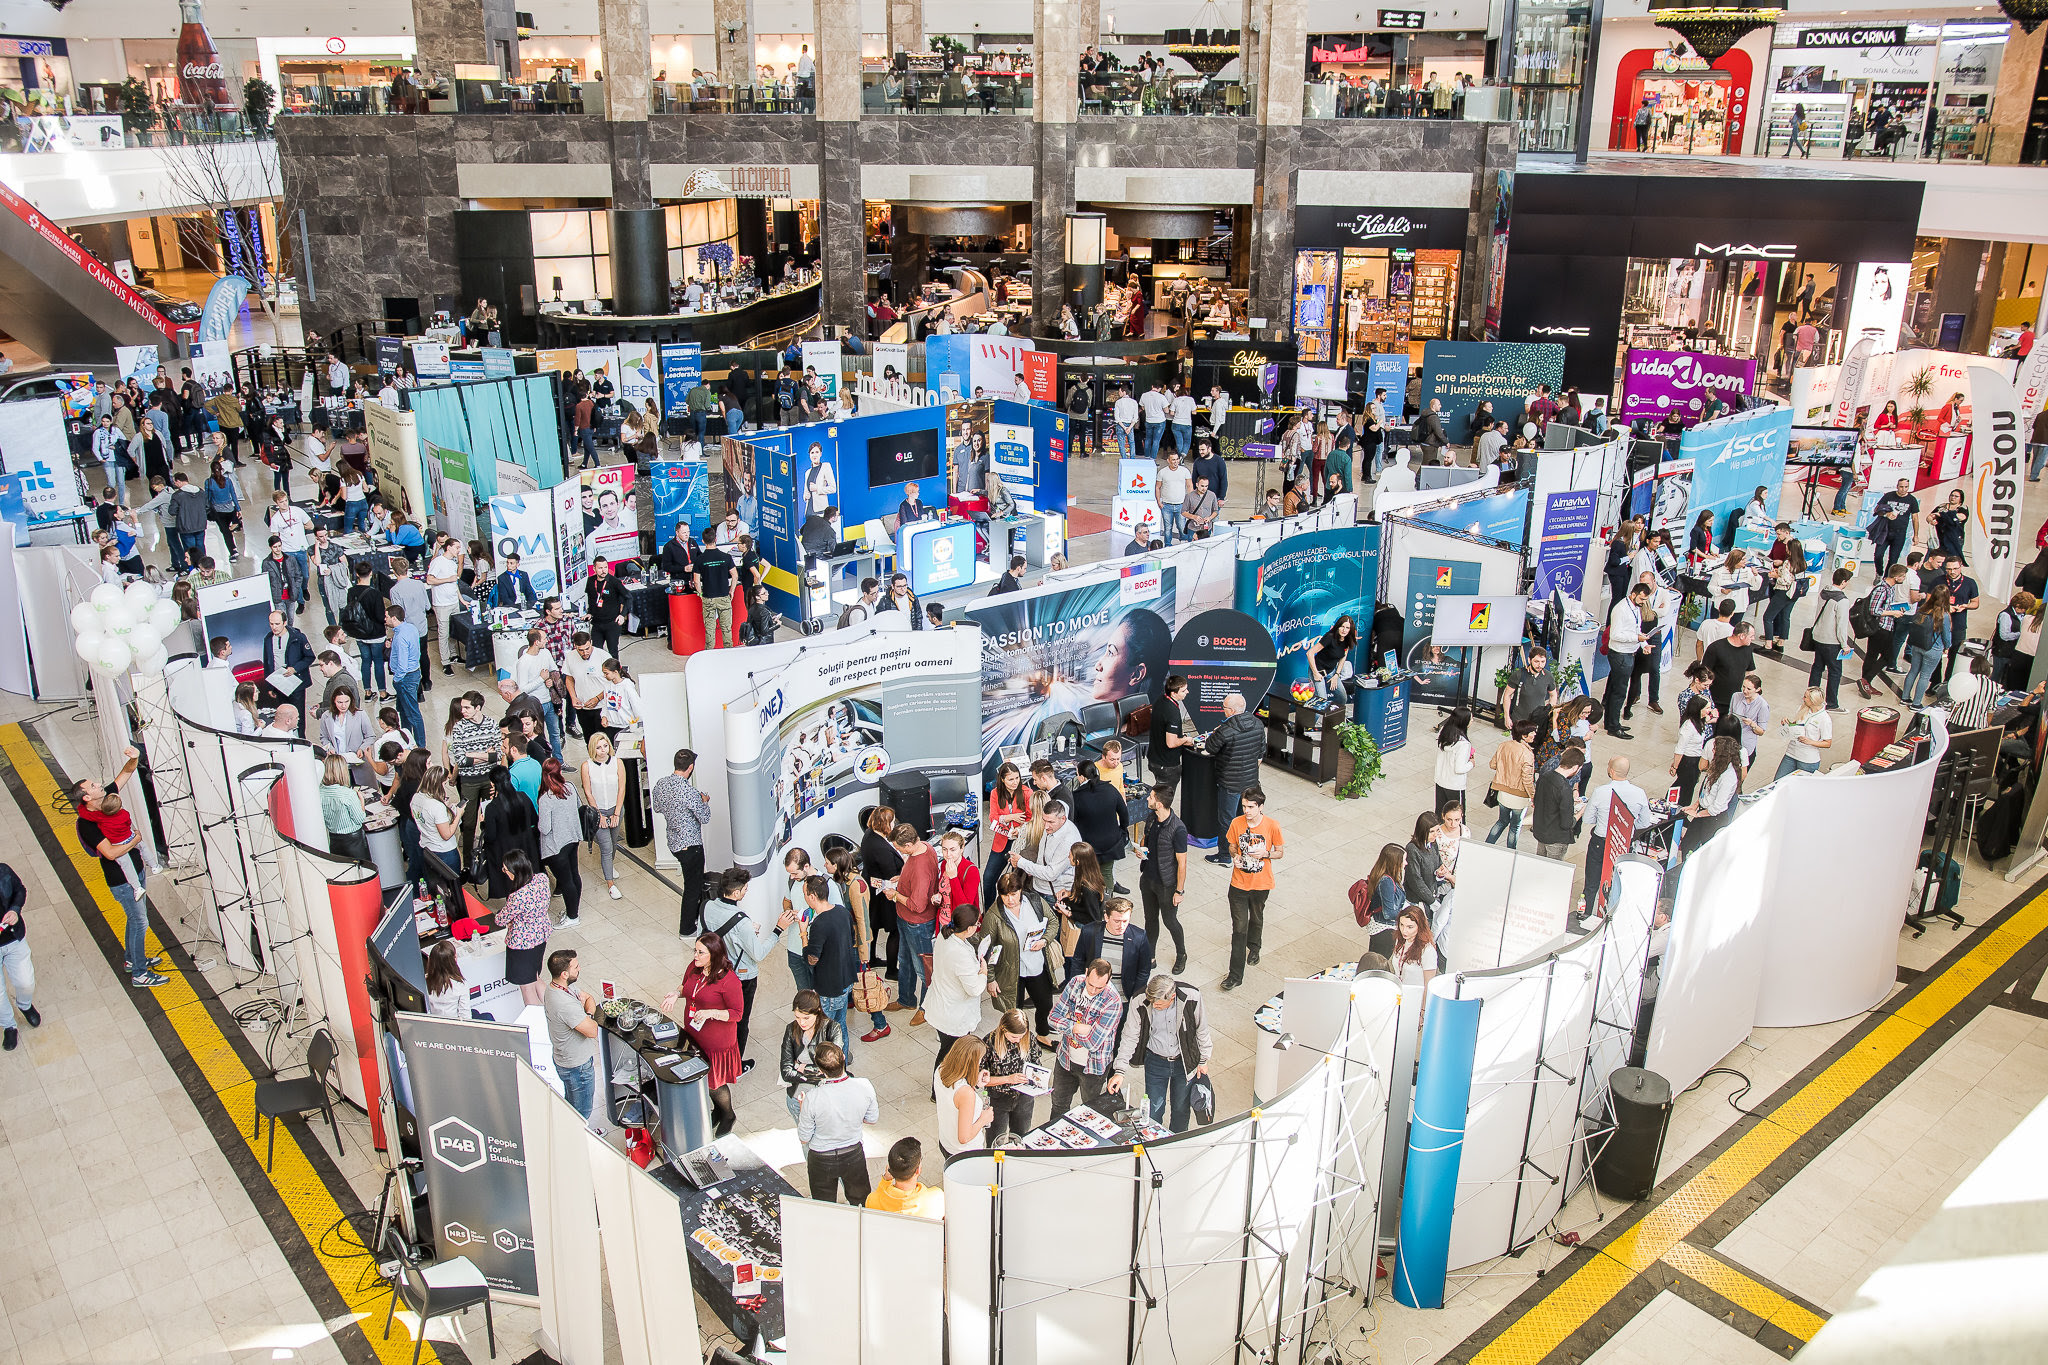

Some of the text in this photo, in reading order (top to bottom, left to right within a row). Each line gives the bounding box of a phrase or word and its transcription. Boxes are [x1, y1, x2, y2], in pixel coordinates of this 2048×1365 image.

[1805, 29, 1896, 46] DONNA CARINA
[1351, 213, 1411, 236] Kiehl's
[40, 224, 63, 247] REGINA
[63, 243, 82, 262] MARIA
[87, 261, 168, 336] CAMPUS MEDICAL
[211, 280, 239, 331] CARIERE
[1233, 350, 1267, 369] Coffee
[664, 370, 702, 378] Leadership
[1233, 368, 1259, 377] POIN
[1435, 372, 1528, 385] one platform for
[2021, 343, 2048, 410] irecredit
[622, 384, 658, 398] BEST
[1434, 383, 1537, 397] all junior develope
[903, 451, 913, 460] LG
[1729, 450, 1775, 472] We make IT work
[1989, 409, 2017, 560] amazon
[1278, 550, 1305, 564] EUROPEAN
[1303, 546, 1328, 557] LEADER
[1292, 552, 1332, 568] TECHNOLOGY
[1331, 548, 1378, 560] CONSULTING
[1134, 578, 1158, 591] BOSCH
[980, 609, 1110, 651] PASSION TO MOVE
[980, 634, 1076, 664] Shape tomorrow's world
[1212, 636, 1248, 647] BOSCH
[817, 646, 911, 678] Soluții pentru mașini
[828, 657, 954, 687] din respect pentru oameni
[483, 977, 512, 993] BRD
[414, 1040, 516, 1059] WE ARE ON THE SAME PAGE
[533, 1064, 547, 1072] RD
[439, 1136, 476, 1153] P4B
[487, 1136, 518, 1149] People
[488, 1145, 502, 1154] for
[449, 1229, 466, 1238] NRS
[500, 1235, 513, 1246] QA
